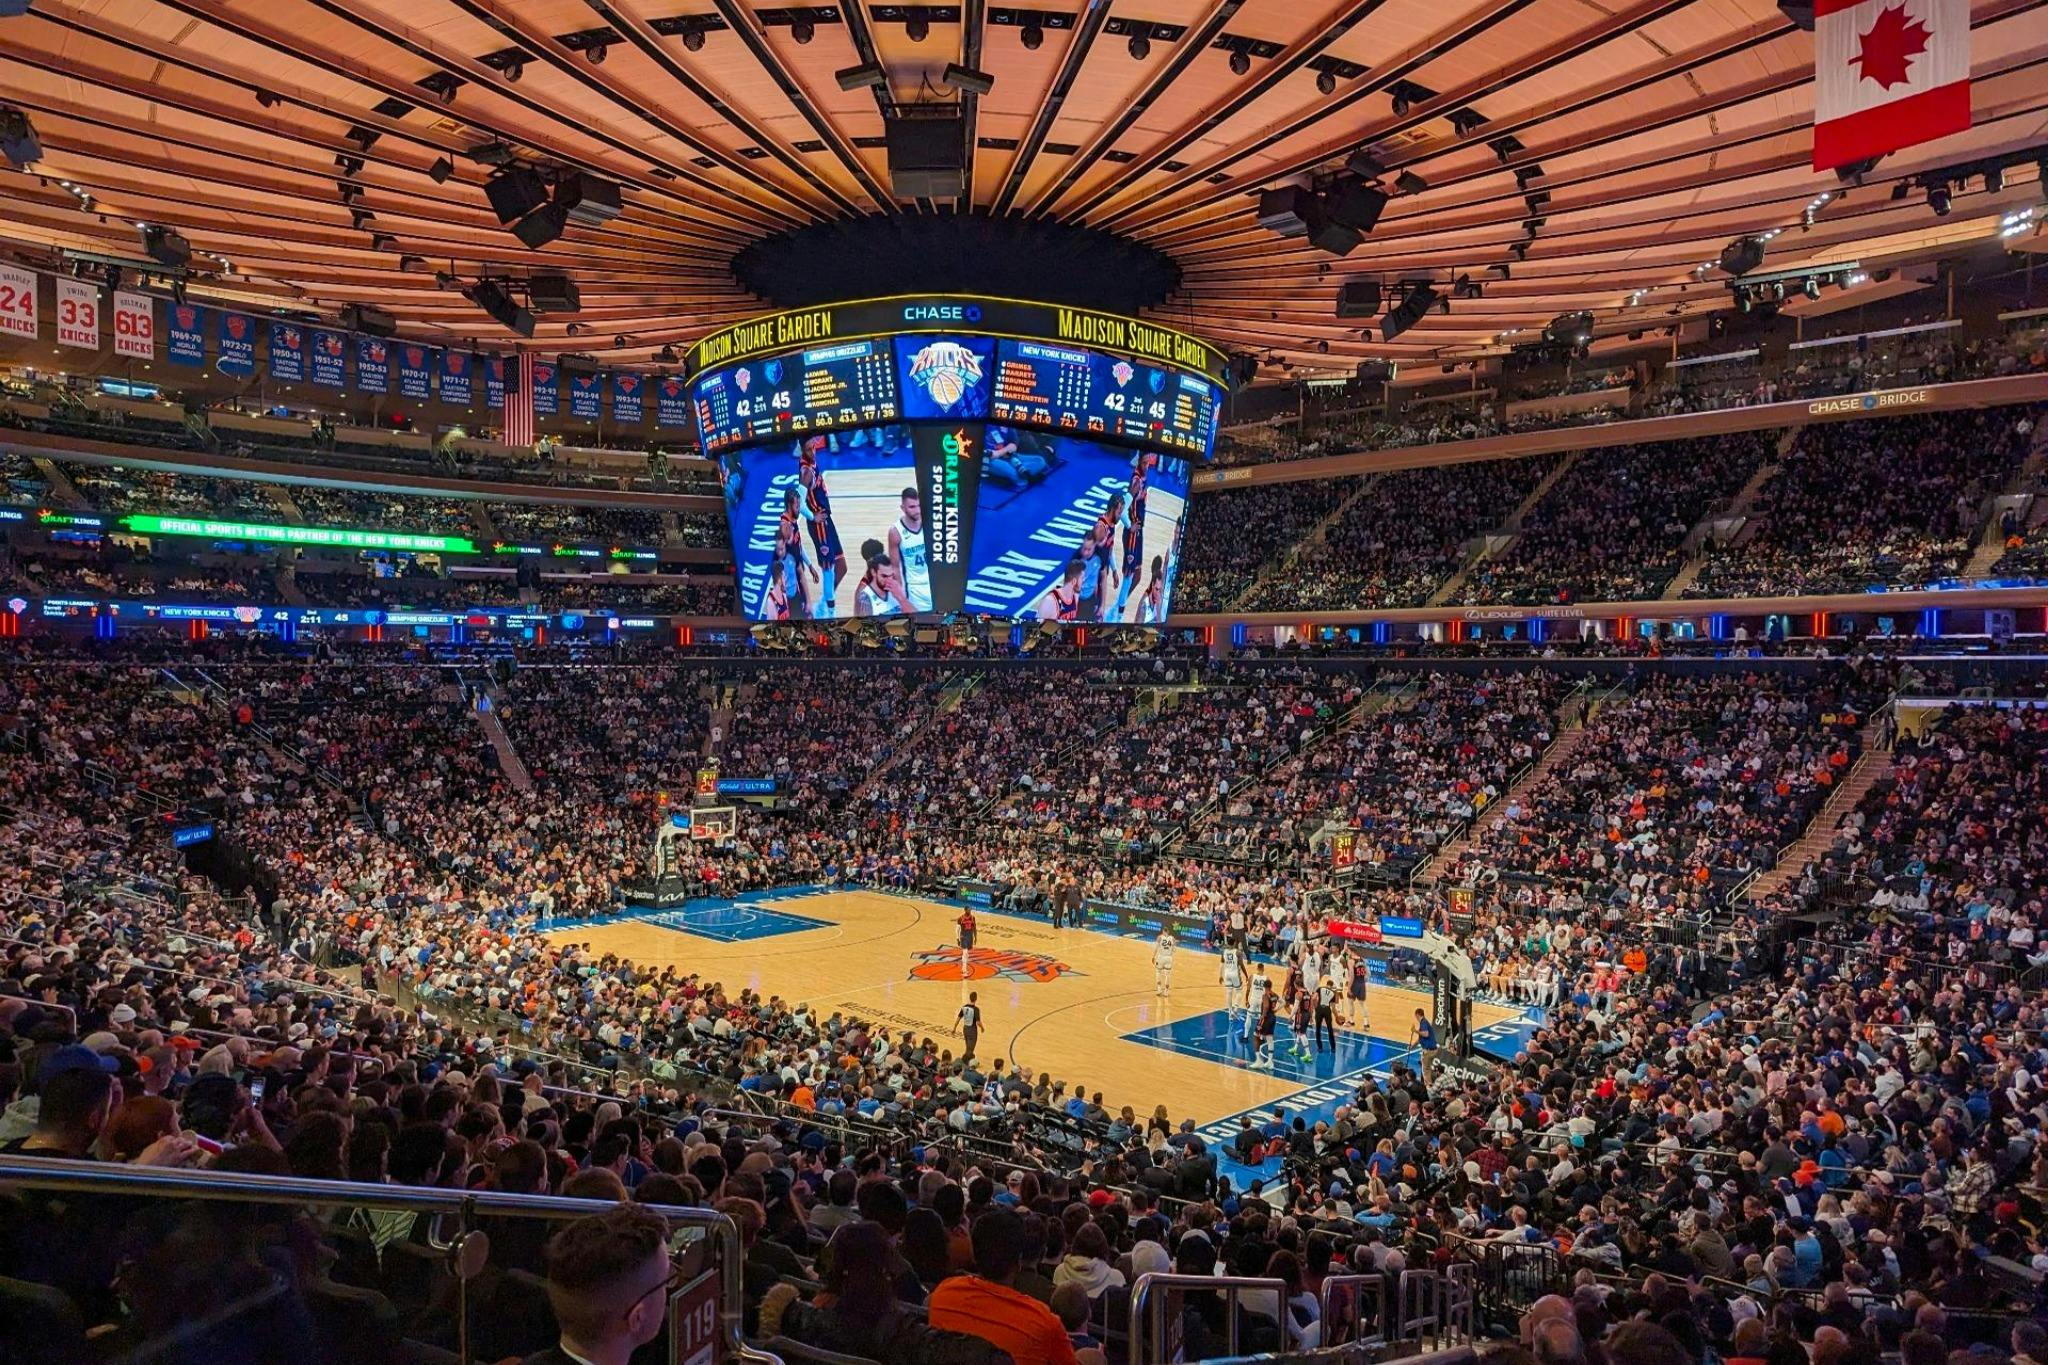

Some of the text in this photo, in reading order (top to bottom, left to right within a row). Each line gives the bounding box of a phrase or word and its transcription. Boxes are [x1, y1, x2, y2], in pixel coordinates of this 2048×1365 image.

[0, 285, 34, 317] 24
[60, 299, 95, 328] 33
[904, 306, 963, 320] CHASE
[0, 315, 35, 334] KNICKS
[115, 310, 152, 338] 613
[60, 328, 96, 344] KNICKS
[171, 330, 202, 343] 1969-70
[700, 311, 831, 367] MADISON SQUARE GARDEN
[1058, 309, 1207, 370] MADISON SQUARE GARDEN
[118, 338, 152, 354] KNICKS
[272, 348, 301, 360] 1950-51
[1022, 345, 1086, 363] NEW YORK KNICKS
[314, 356, 343, 367] 1951-52
[359, 362, 387, 373] 1952-53
[401, 369, 428, 379] 1970-71
[442, 375, 469, 385] 1971-72
[1005, 369, 1036, 378] BARRETT
[736, 399, 751, 416] 42
[754, 402, 767, 413] 2:11
[771, 391, 791, 409] 45
[1104, 392, 1125, 412] 42
[1808, 391, 1927, 414] CHASE BRIDGE
[1130, 403, 1144, 414] 2:11
[1149, 401, 1166, 419] 45
[816, 417, 833, 427] 50.0
[839, 412, 857, 423] 43.6
[864, 411, 875, 420] 17
[883, 408, 895, 417] 39
[995, 409, 1007, 418] 16
[1015, 411, 1027, 420] 39
[1031, 414, 1051, 424] 41.0
[1060, 417, 1078, 428] 72.7
[1088, 422, 1104, 432] 14.3
[1225, 468, 1252, 480] BRIDGE
[942, 433, 959, 564] DRAFTKINGS
[40, 514, 101, 526] DRAFTKINGS
[748, 474, 800, 552] KNICKS
[932, 465, 943, 562] SPORTSBOOK
[160, 520, 202, 532] OFFICIAL
[205, 524, 243, 536] SPORTS
[246, 527, 285, 539] BETTING
[287, 530, 330, 541] PARTNER
[332, 533, 342, 541] OF
[348, 534, 363, 544] THE
[365, 536, 386, 545] NEW
[389, 537, 411, 546] YORK
[965, 476, 1131, 611] YORK KNICKS
[741, 561, 769, 616] YORK
[164, 608, 230, 617] NEW YORK KNICKS
[274, 611, 288, 620] 42
[300, 615, 321, 624] 2:11
[335, 613, 348, 622] 45
[1481, 609, 1584, 618] LEXUS SUITE LEVEL
[701, 780, 714, 791] 24
[1337, 848, 1350, 865] 24
[1455, 901, 1468, 911] 24
[1352, 928, 1366, 936] State
[1161, 939, 1172, 947] 24
[1356, 967, 1365, 976] 55
[1435, 979, 1445, 1026] Spectrum
[1282, 1085, 1351, 1112] YORK
[683, 1298, 715, 1350] 119
